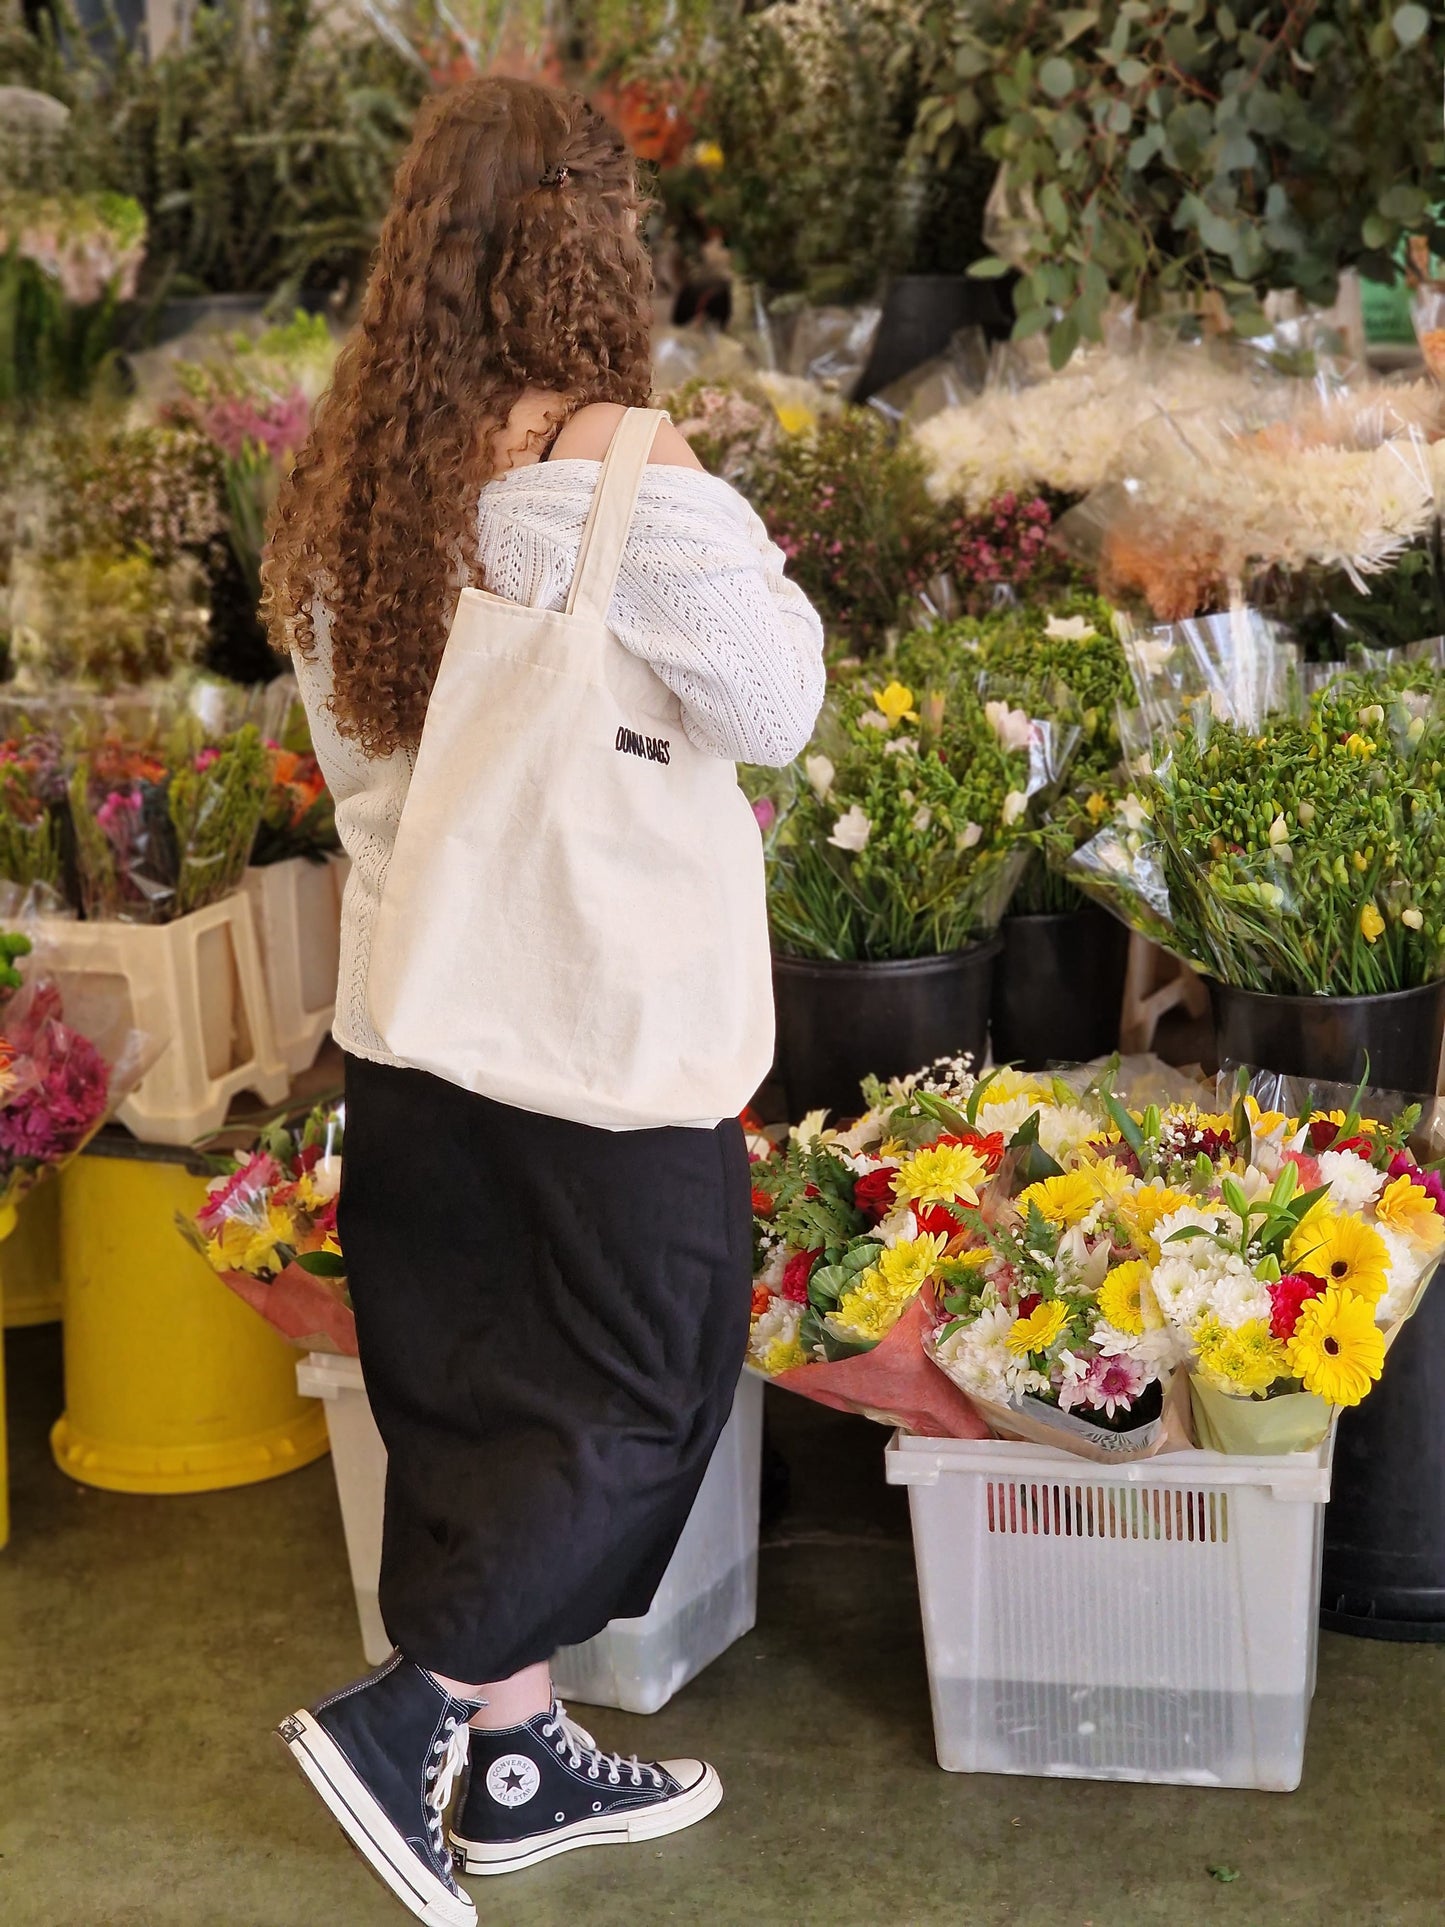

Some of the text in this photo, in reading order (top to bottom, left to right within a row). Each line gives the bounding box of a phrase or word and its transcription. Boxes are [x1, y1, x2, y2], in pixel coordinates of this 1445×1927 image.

[615, 726, 671, 765] DONNA BAGS
[493, 1760, 531, 1777] CONVERSE
[498, 1792, 511, 1801] ALL
